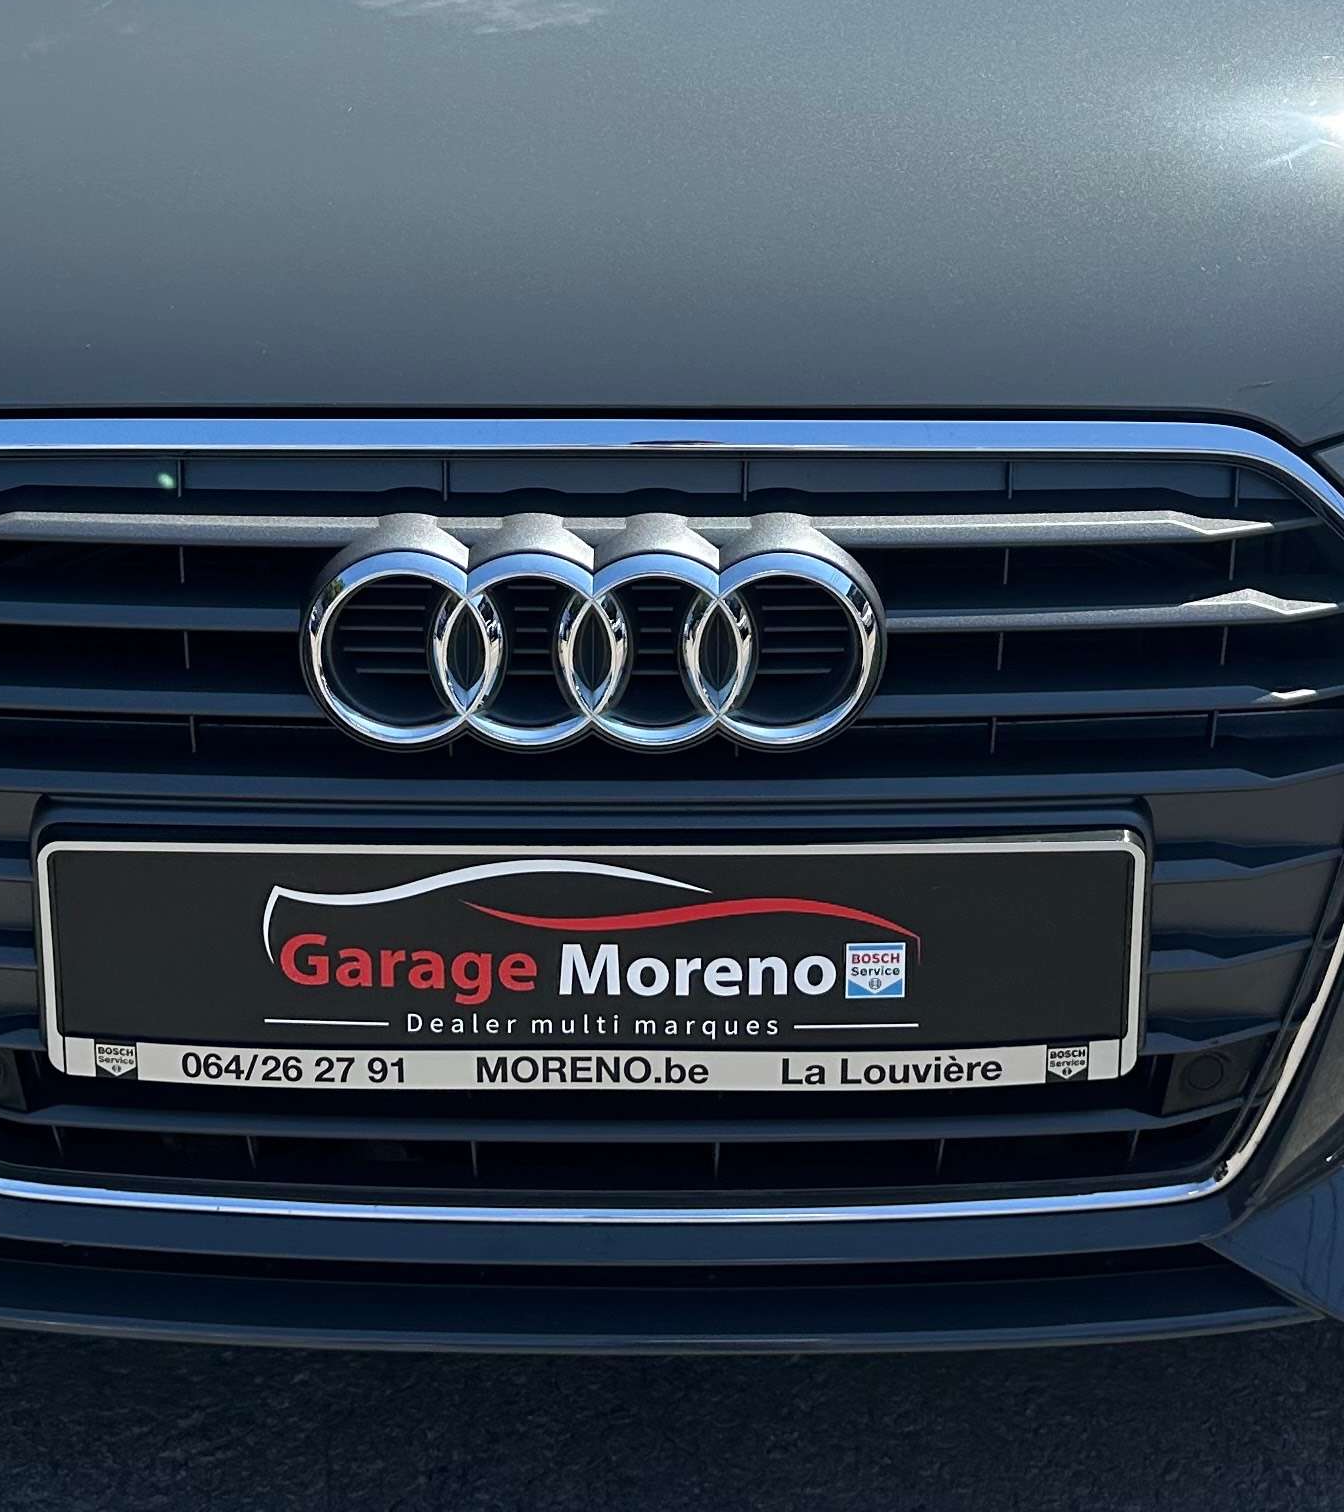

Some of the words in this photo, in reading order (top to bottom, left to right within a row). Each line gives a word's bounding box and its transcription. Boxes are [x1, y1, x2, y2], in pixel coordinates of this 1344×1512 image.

[851, 953, 900, 964] BOSCH
[279, 933, 538, 1005] Garage
[558, 943, 837, 996] Moreno
[851, 965, 900, 976] Service
[406, 1013, 517, 1034] Dealer
[531, 1014, 620, 1035] multi
[634, 1017, 780, 1040] marques
[97, 1046, 134, 1057] BOSCH
[1049, 1048, 1086, 1059] BOSCH
[98, 1055, 135, 1065] Service
[1049, 1058, 1086, 1068] Service
[181, 1052, 304, 1082] 064/26
[314, 1056, 356, 1083] 27
[367, 1056, 406, 1083] 91
[476, 1055, 710, 1084] MORENO.be
[781, 1057, 826, 1085] La
[839, 1055, 1004, 1085] Louvière
